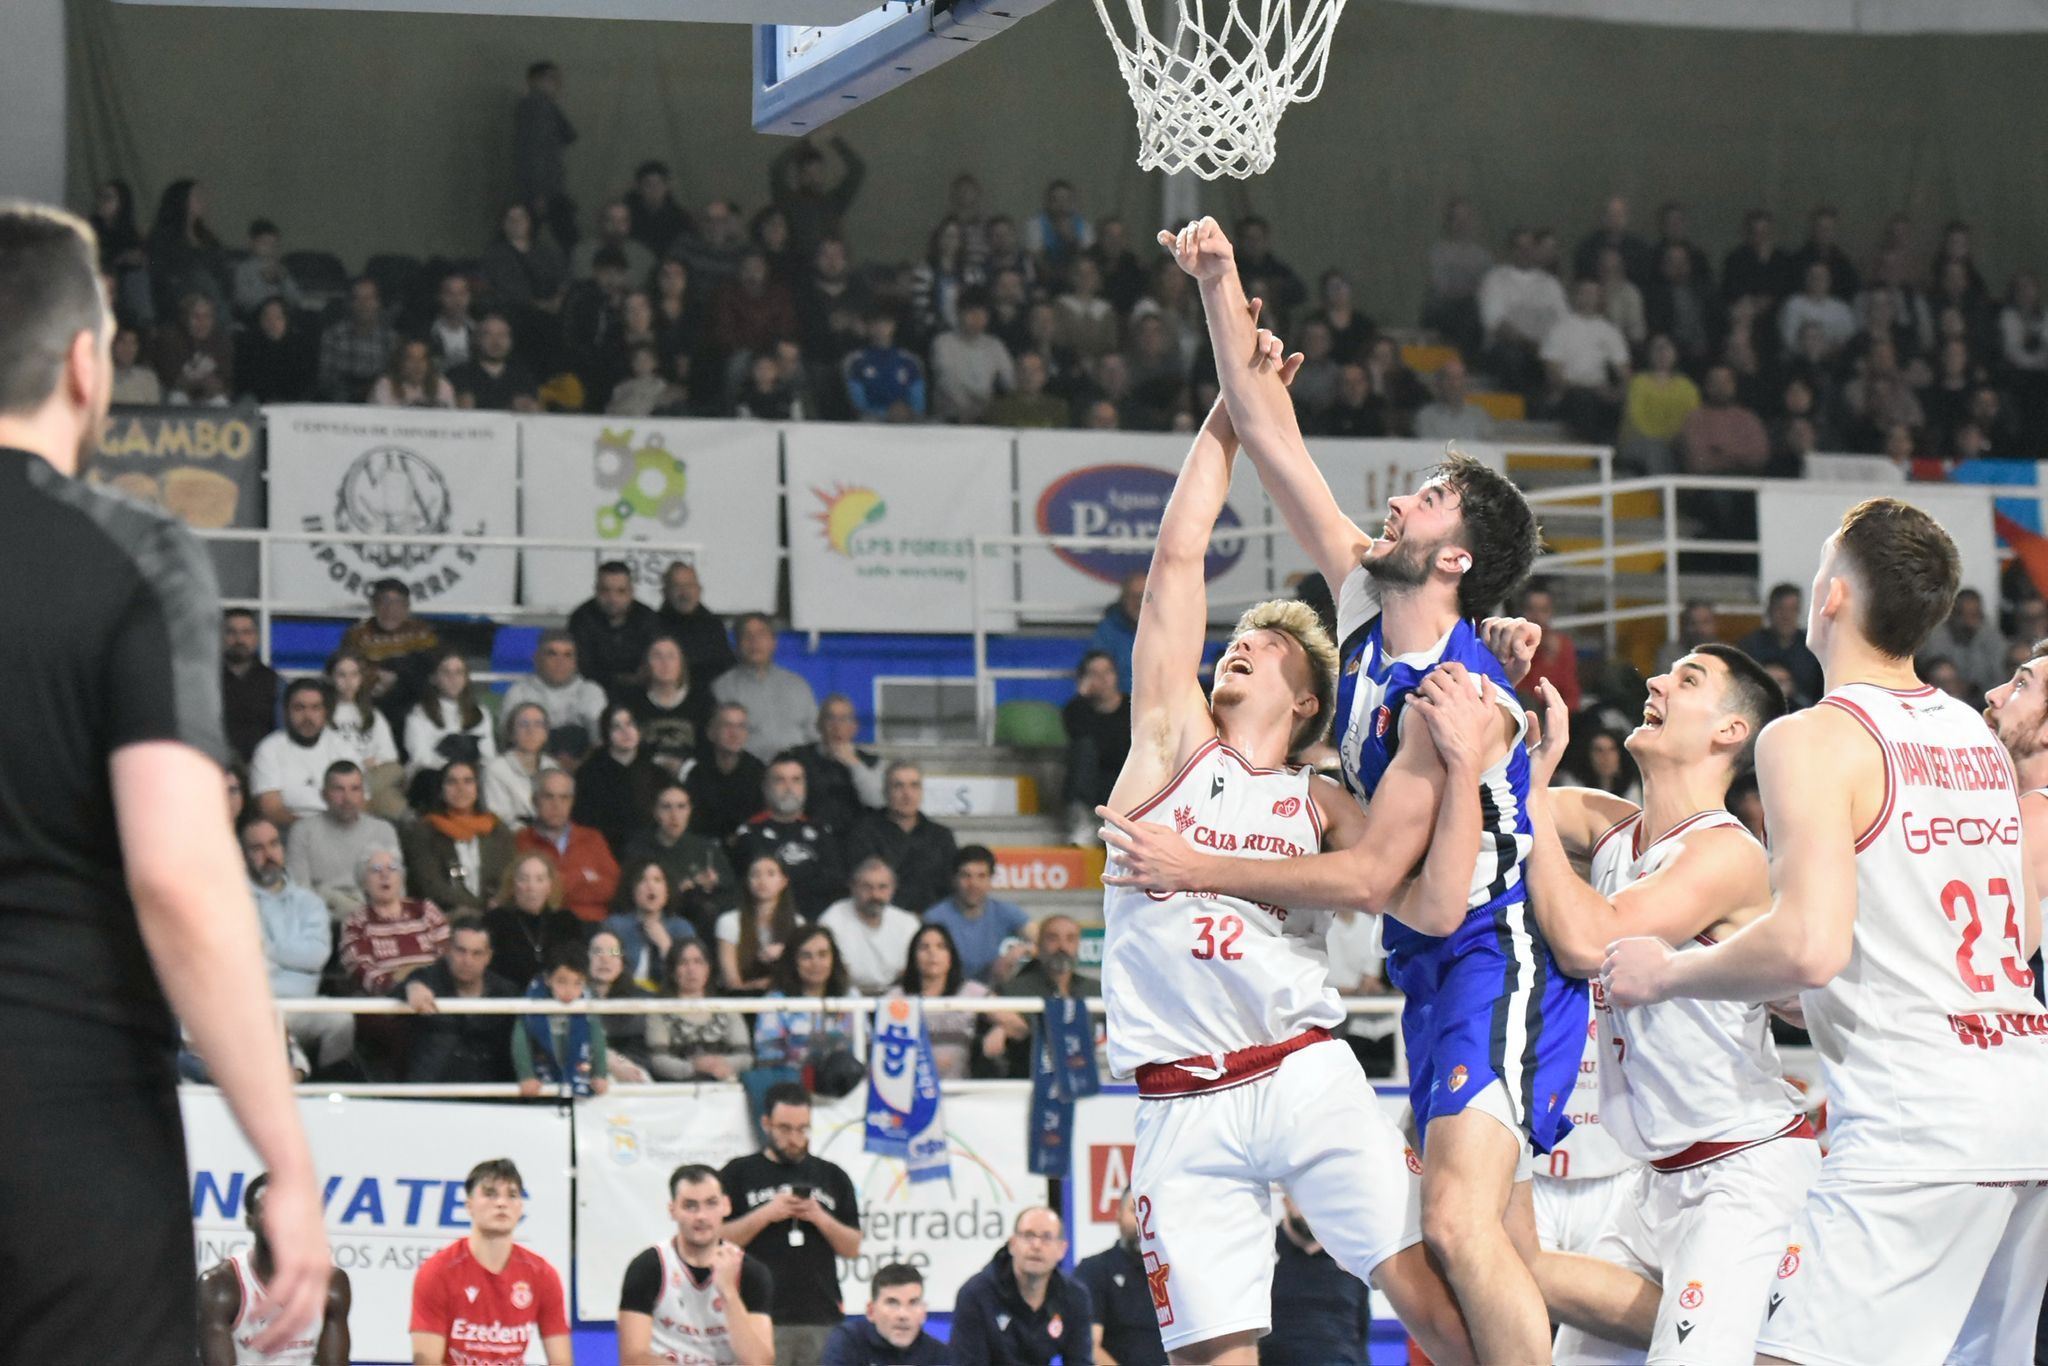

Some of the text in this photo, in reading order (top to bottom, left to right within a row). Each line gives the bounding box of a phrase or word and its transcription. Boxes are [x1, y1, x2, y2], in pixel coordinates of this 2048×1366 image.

[1193, 826, 1237, 851] CAJA
[991, 859, 1069, 889] auto
[1191, 915, 1244, 960] 32
[1940, 877, 2034, 993] 23
[859, 1198, 1004, 1240] ferrada
